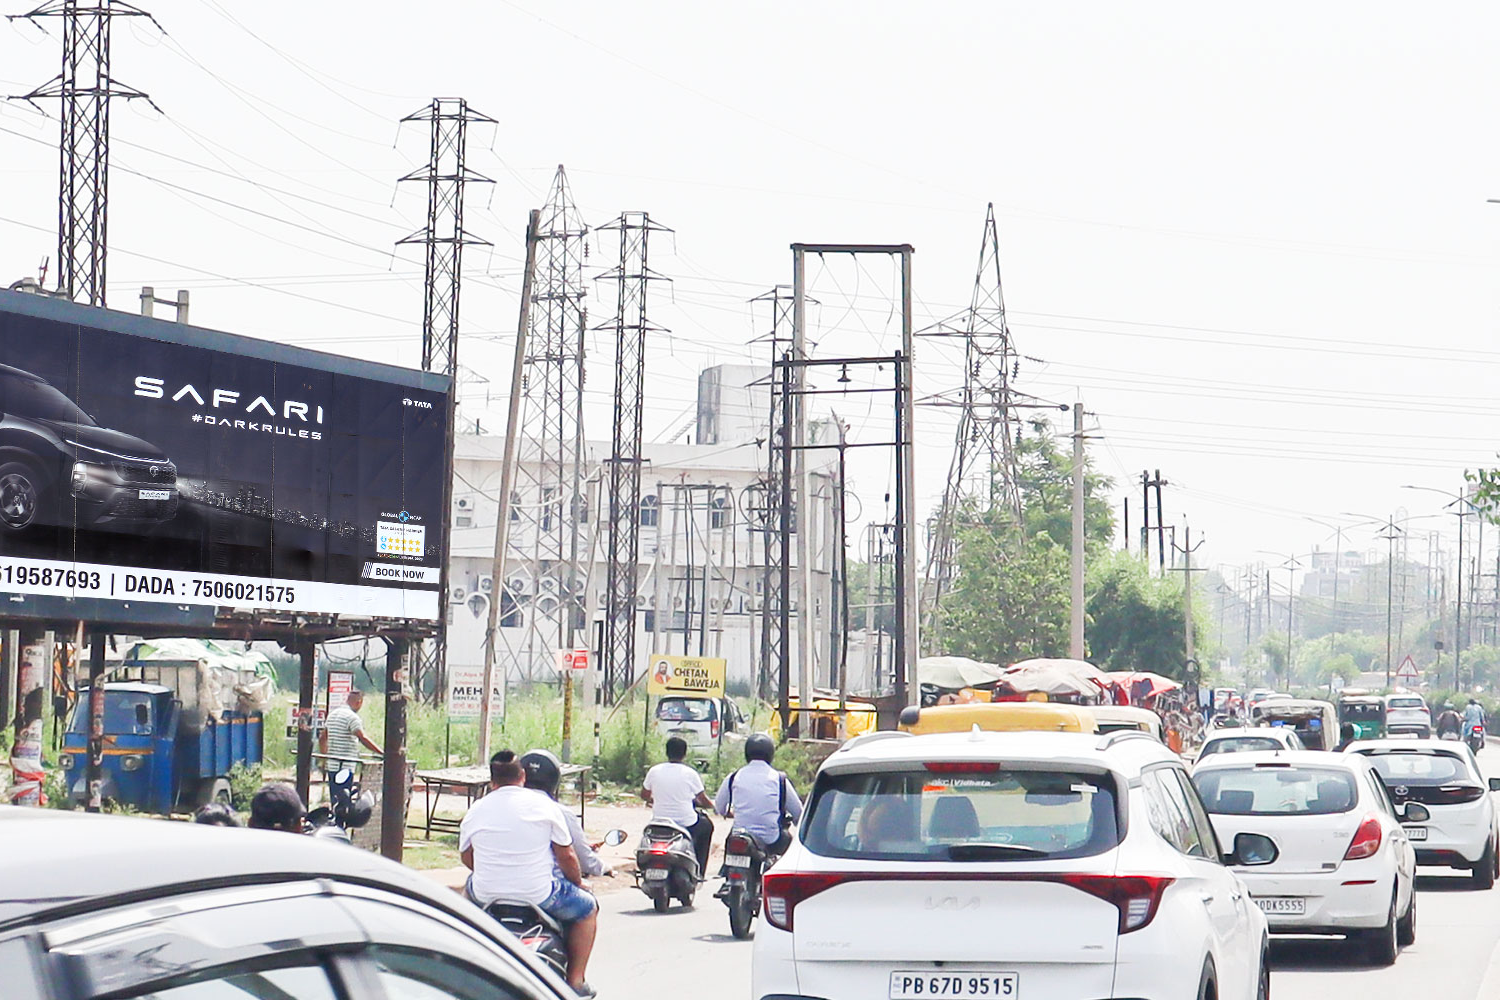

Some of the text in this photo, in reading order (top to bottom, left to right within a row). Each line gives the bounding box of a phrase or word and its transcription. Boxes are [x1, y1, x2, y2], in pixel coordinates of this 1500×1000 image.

[134, 376, 324, 424] SAFARI
[413, 400, 432, 409] TATA
[192, 413, 322, 441] #DARKRULES
[376, 568, 424, 579] BOOK NOW
[125, 574, 175, 595] DADA
[192, 579, 295, 603] 7506021575
[674, 668, 708, 678] CHETAN
[684, 678, 719, 688] BAWEJA
[453, 687, 499, 695] MEHA
[903, 977, 1012, 995] PB 67D 9515
